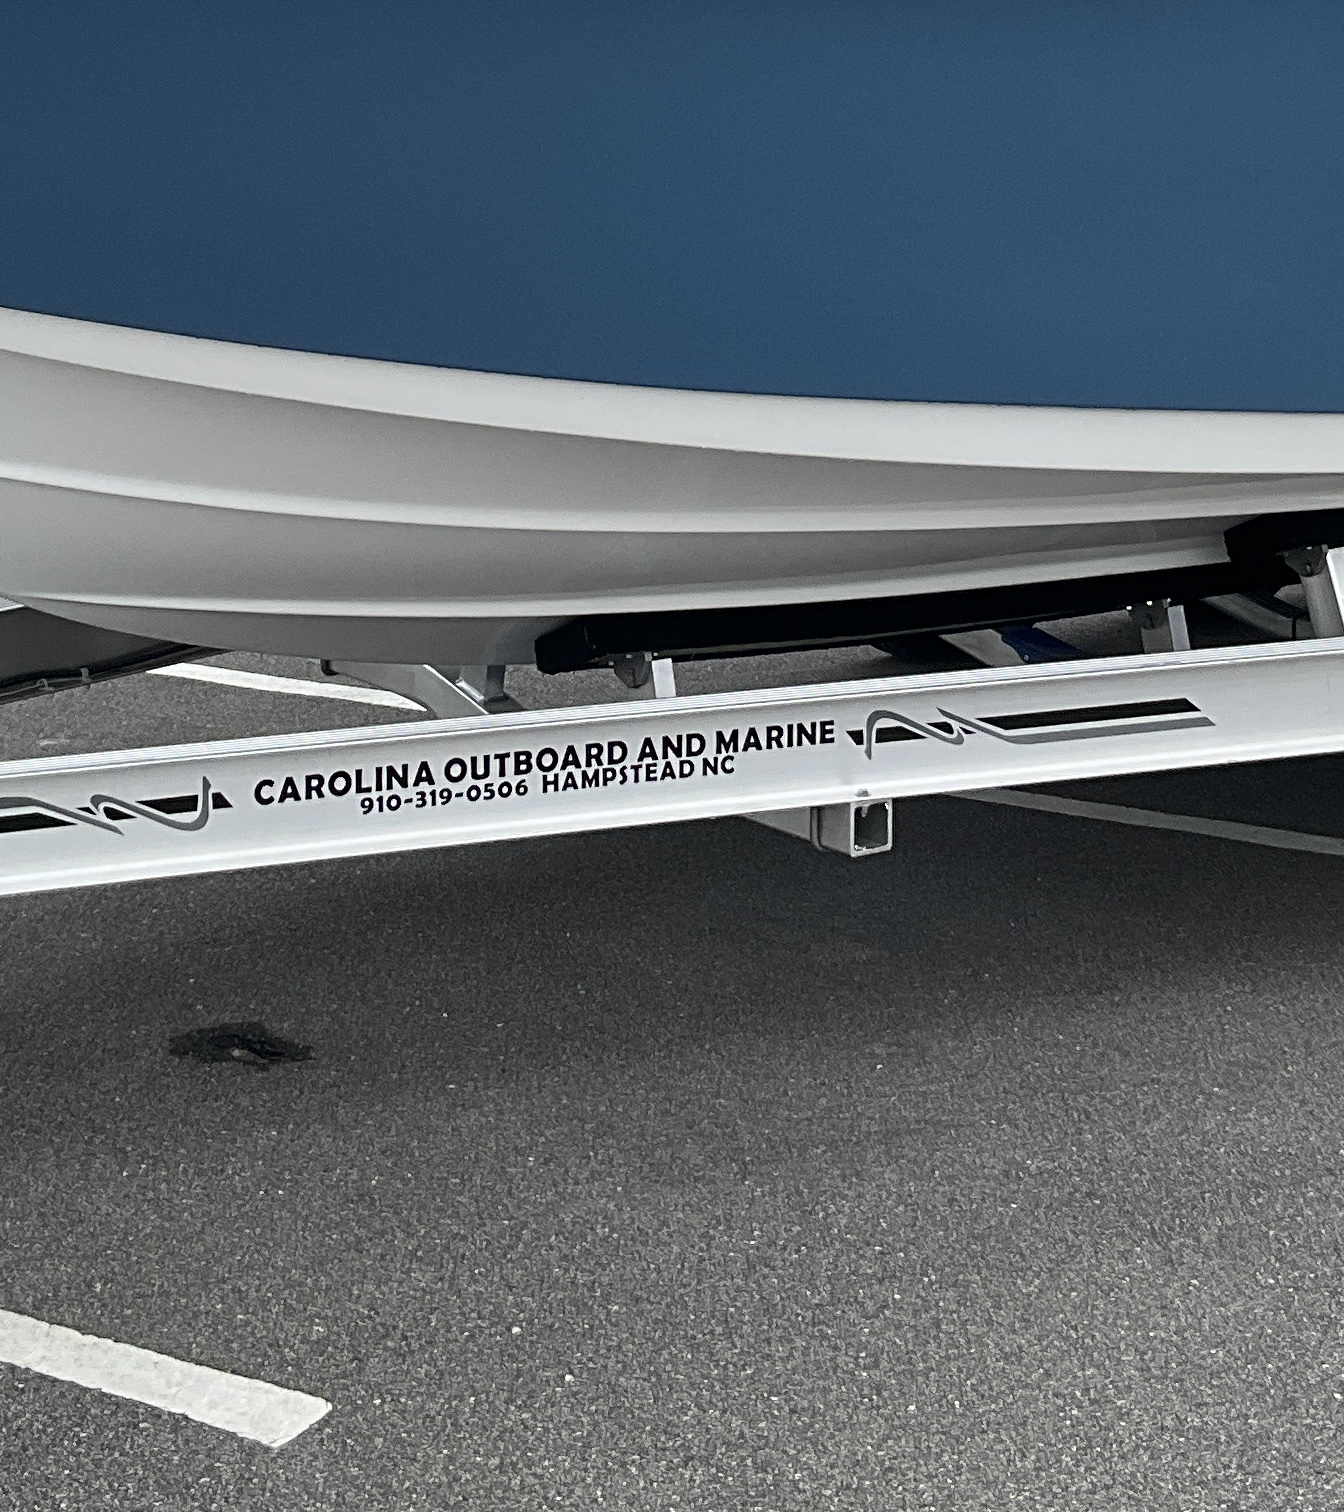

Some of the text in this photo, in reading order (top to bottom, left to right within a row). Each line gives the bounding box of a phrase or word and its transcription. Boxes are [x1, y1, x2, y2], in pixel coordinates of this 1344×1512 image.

[254, 719, 836, 805] CAROLINA OUTBOARD AND MARINE
[359, 754, 736, 815] 910-319-0506 HAMPSTEAD NC
